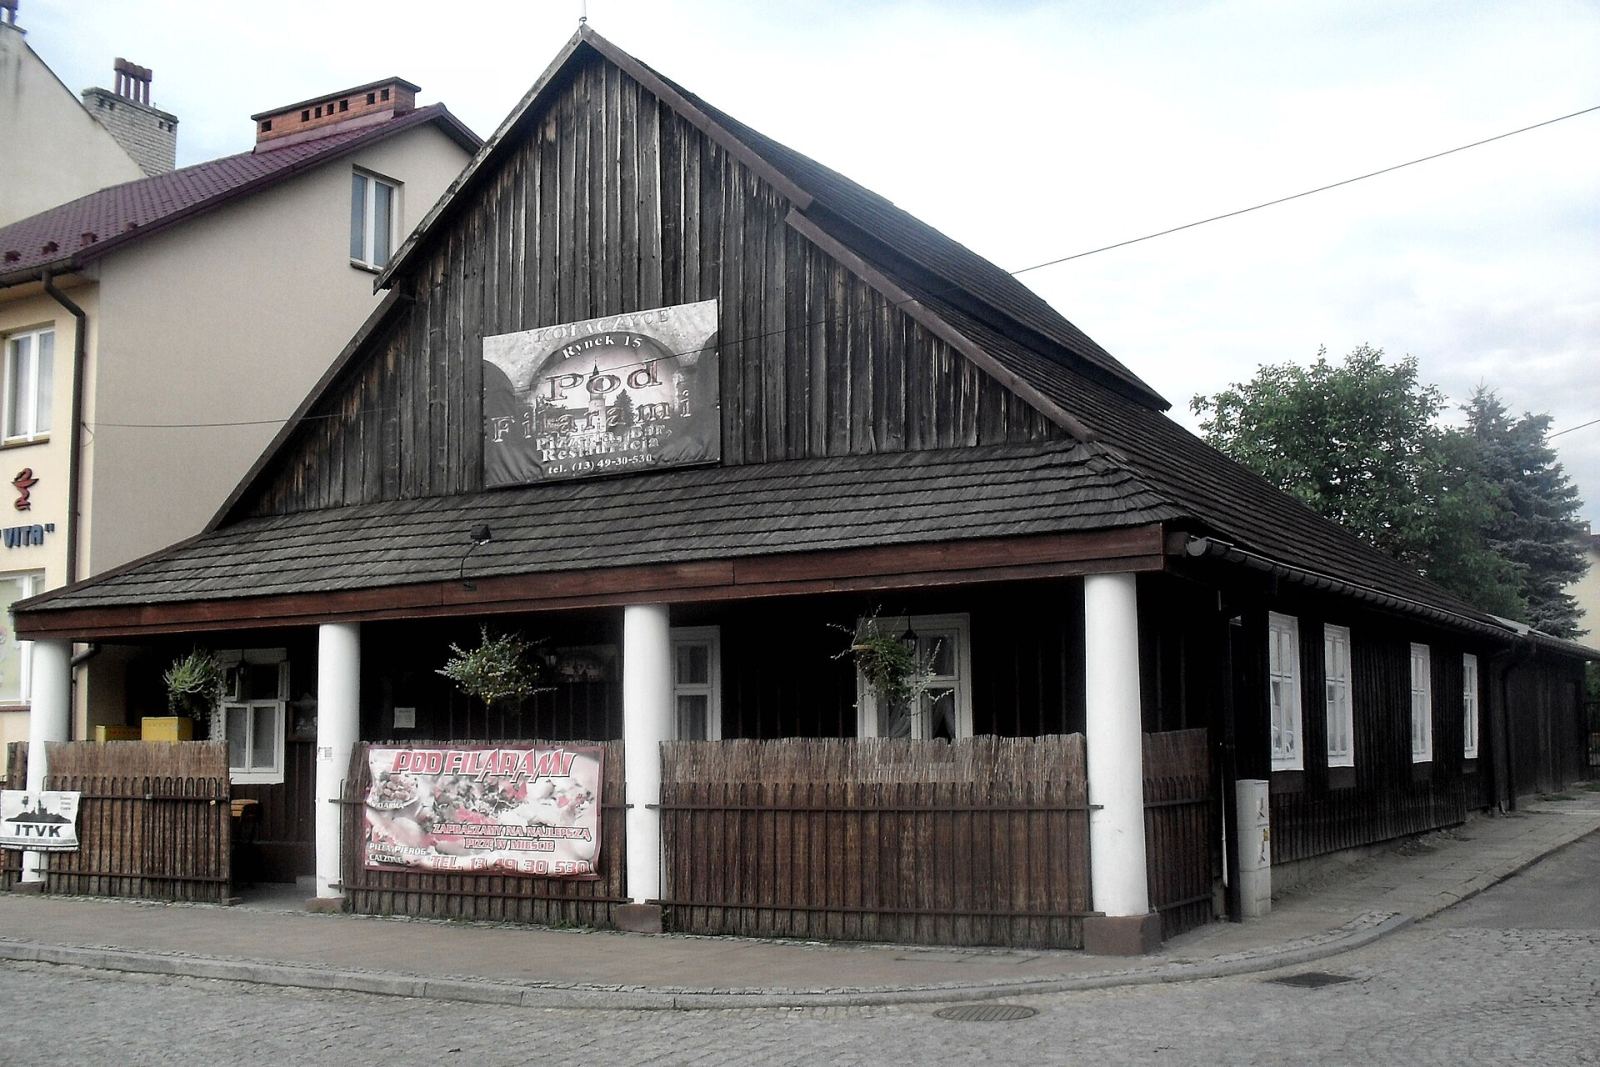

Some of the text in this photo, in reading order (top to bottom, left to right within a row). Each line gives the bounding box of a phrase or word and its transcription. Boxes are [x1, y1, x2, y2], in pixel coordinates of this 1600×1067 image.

[561, 335, 643, 360] Rynek 15
[546, 358, 663, 401] Pod
[491, 389, 692, 443] Filarami
[548, 453, 653, 475] tel. (13) 49-30-530
[389, 748, 577, 784] POD FILARAMI
[15, 824, 63, 838] ITVK
[432, 823, 592, 842] ZAPRASZAMY NA NAJLEPSZĄ
[495, 838, 507, 850] W
[432, 855, 463, 871] TEL.
[470, 857, 488, 870] 13
[524, 860, 549, 874] 30
[554, 860, 590, 875] 530
